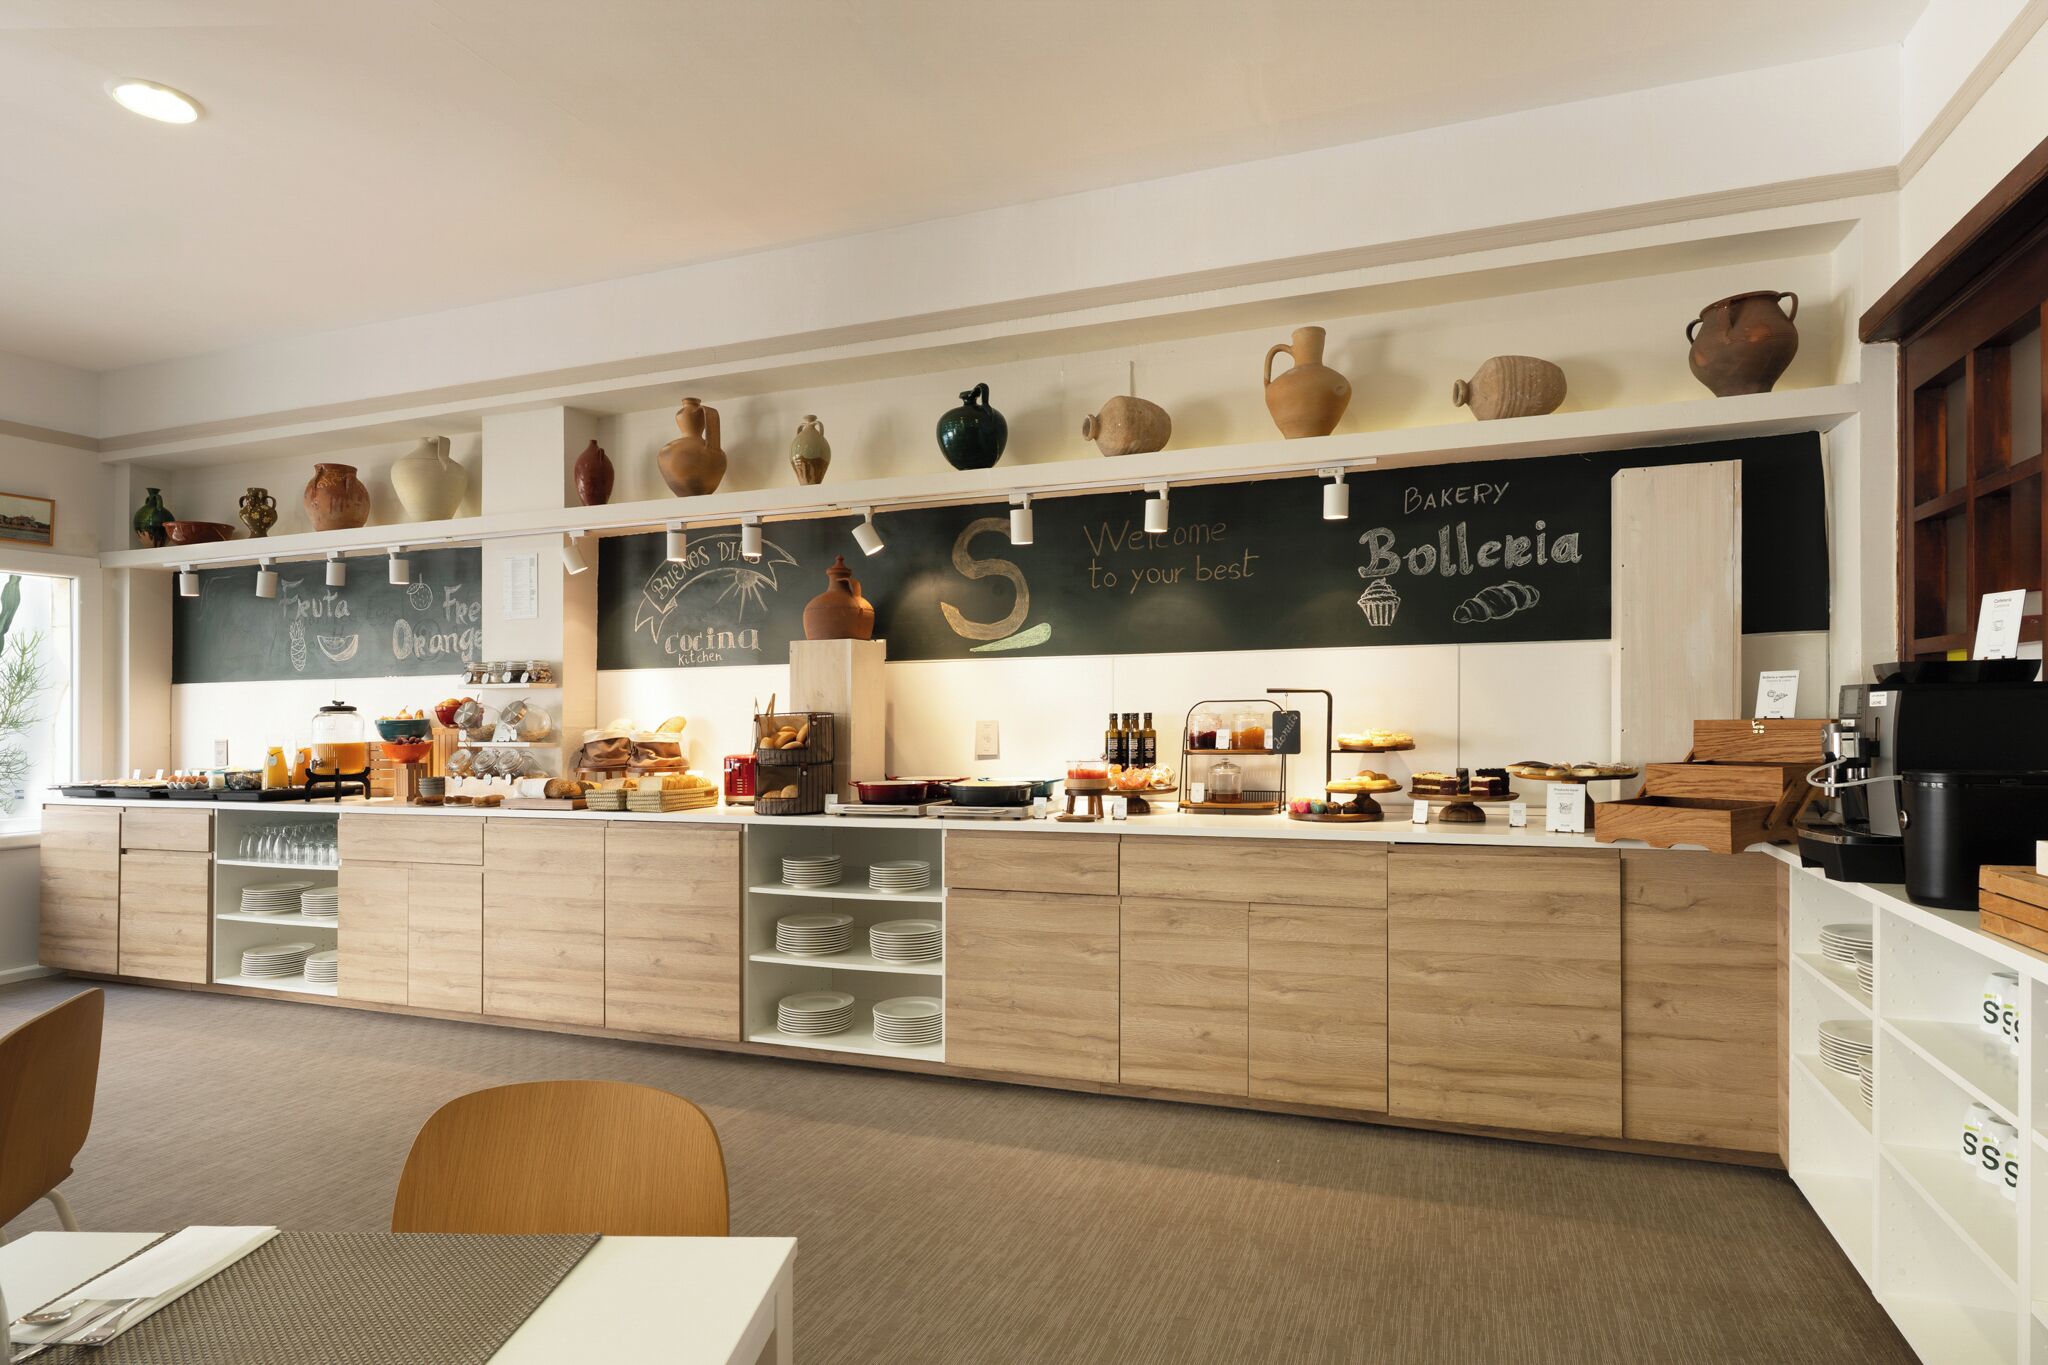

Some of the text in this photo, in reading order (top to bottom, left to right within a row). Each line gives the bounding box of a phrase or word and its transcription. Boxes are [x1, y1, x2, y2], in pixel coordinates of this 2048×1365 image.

[1404, 482, 1509, 514] BAKERY
[651, 545, 710, 600] BUENOS
[1088, 548, 1259, 594] to your best
[678, 650, 723, 666] Kitchen
[1983, 1000, 2000, 1024] S
[1963, 1131, 1978, 1155] S
[1981, 1145, 2000, 1170] S
